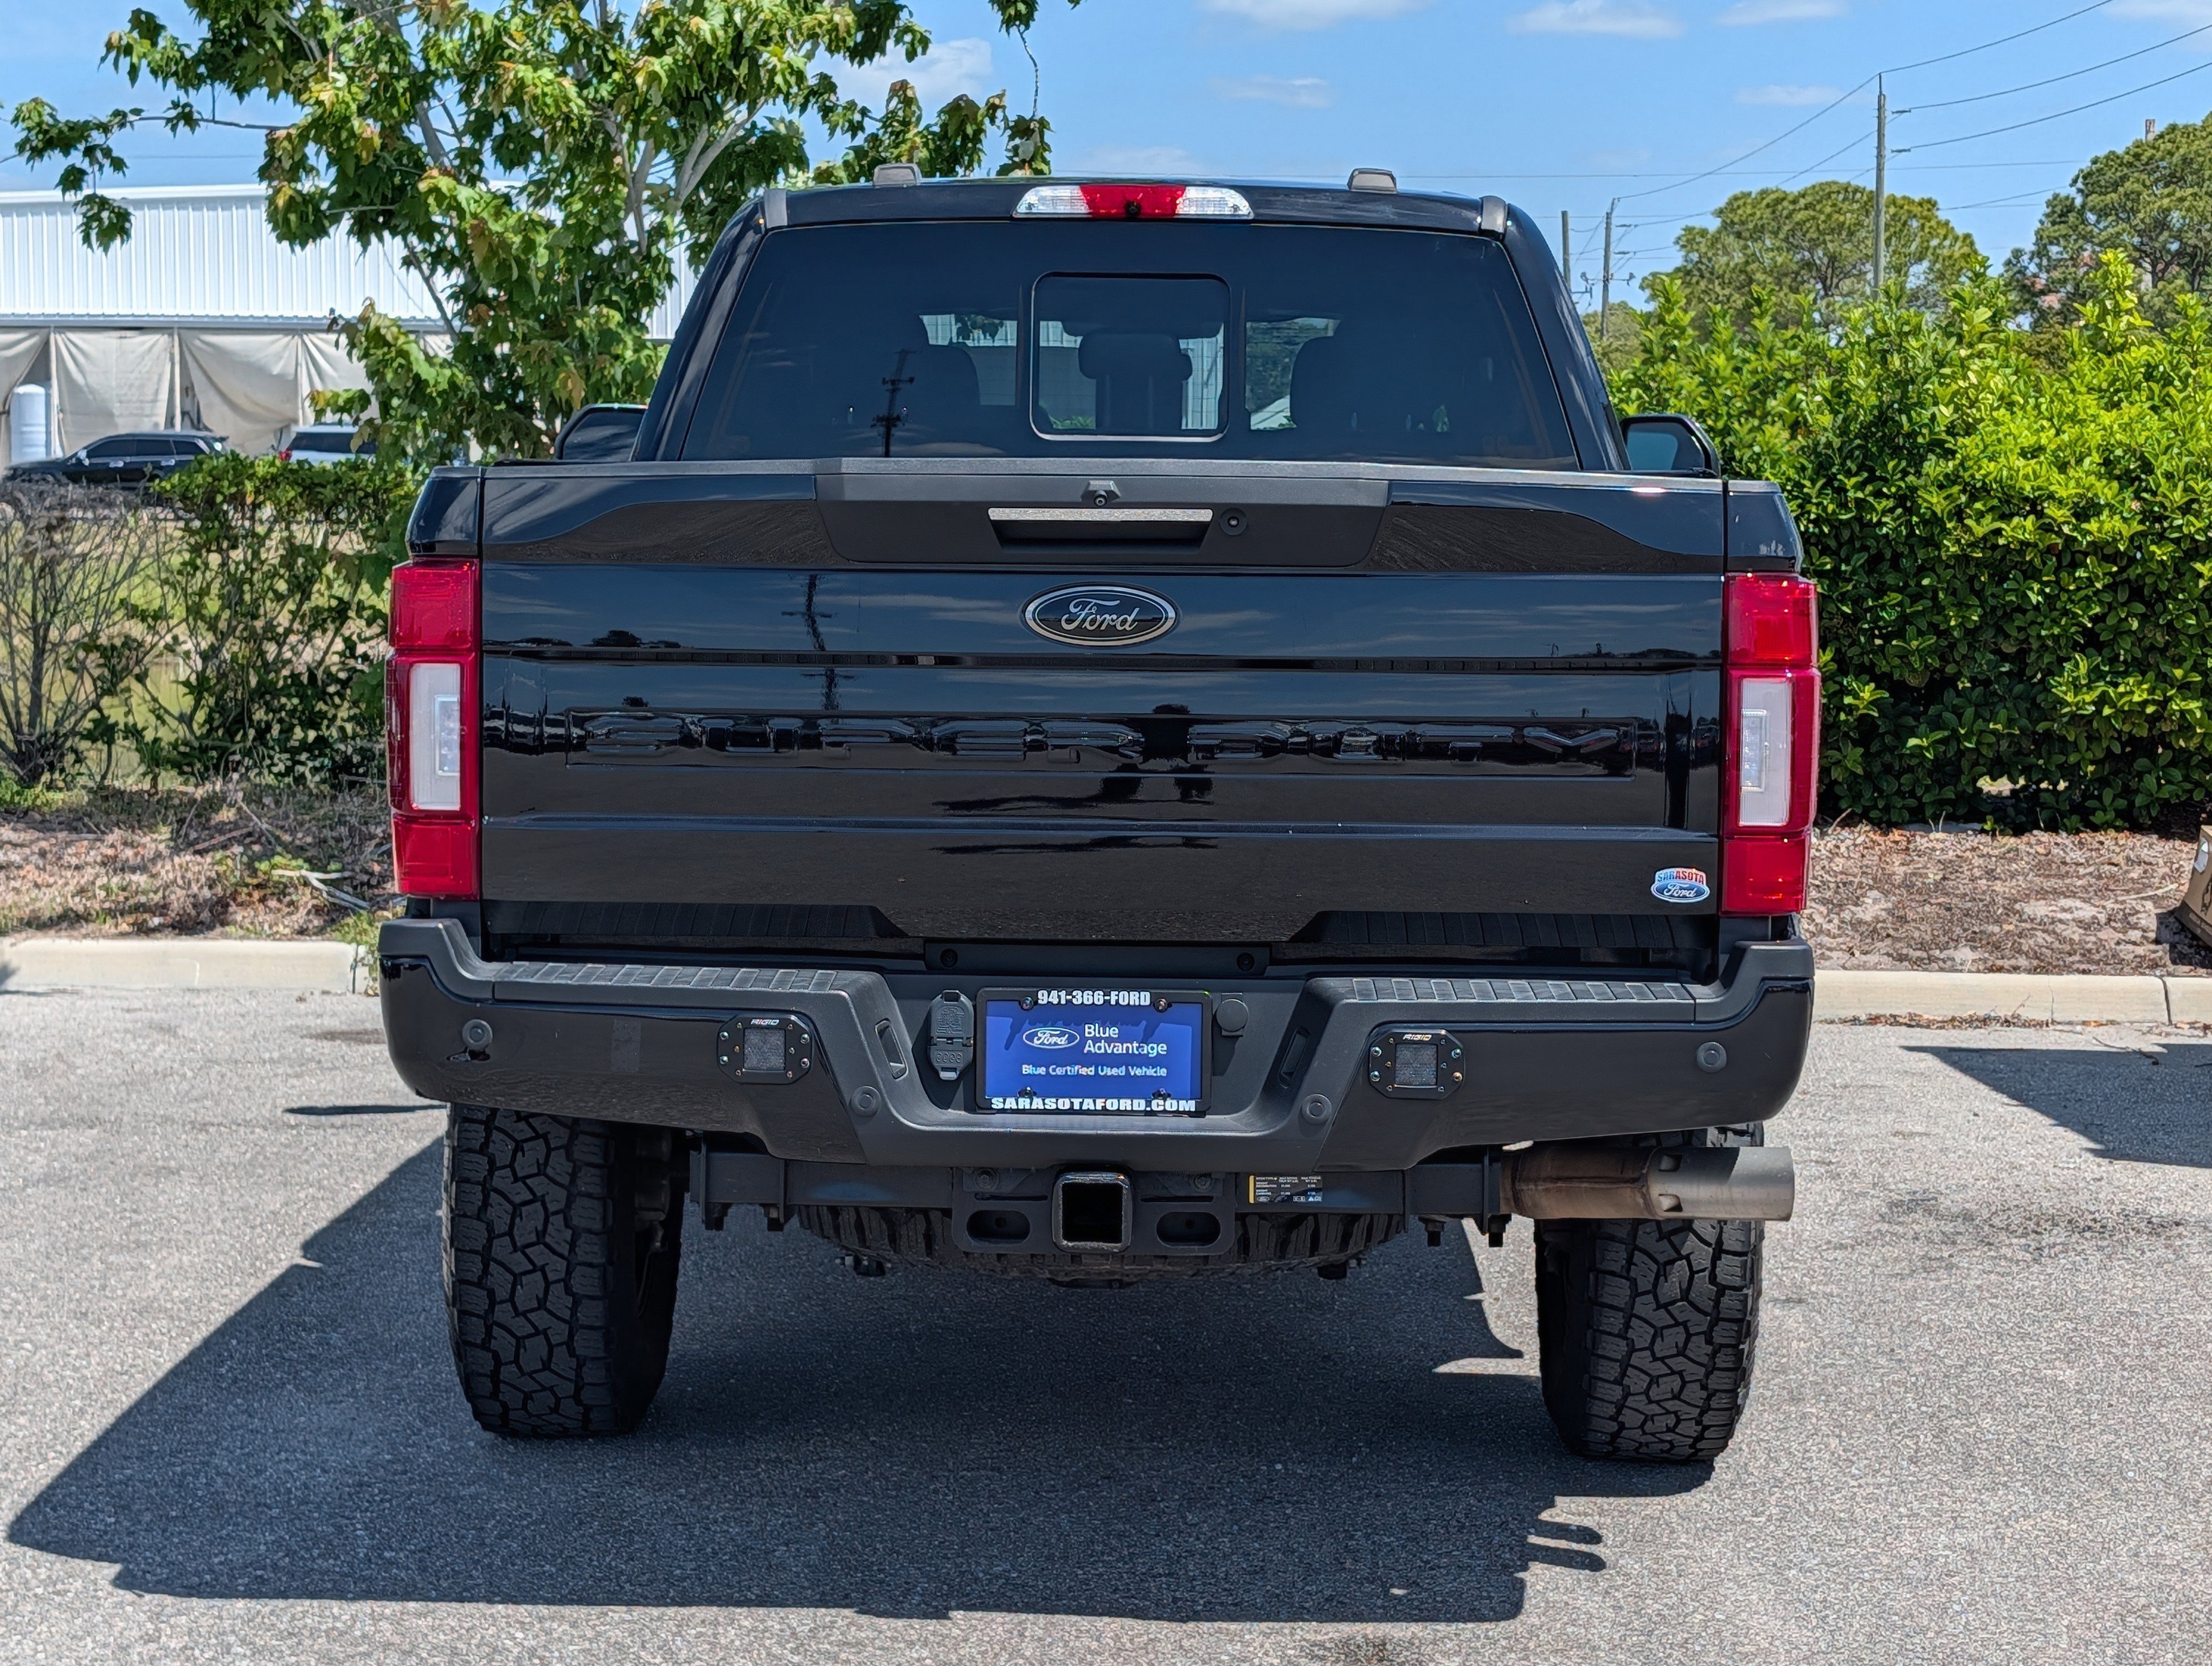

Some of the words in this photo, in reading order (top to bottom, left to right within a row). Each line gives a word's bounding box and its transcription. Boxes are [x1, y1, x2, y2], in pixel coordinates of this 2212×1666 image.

[1060, 598, 1140, 631] Ford
[1657, 870, 1704, 885] SARASOTA
[1663, 882, 1697, 897] Ford
[1038, 990, 1151, 1006] 941-366-FORD
[1033, 1030, 1069, 1045] Ford
[1084, 1023, 1119, 1038] Blue
[1084, 1040, 1167, 1057] Advantage
[1022, 1065, 1046, 1074] Blue
[1049, 1065, 1095, 1075] Certified
[1098, 1065, 1126, 1076] Used
[1128, 1066, 1167, 1077] Vehicle
[991, 1097, 1196, 1112] SARASOTAFORD.COM
